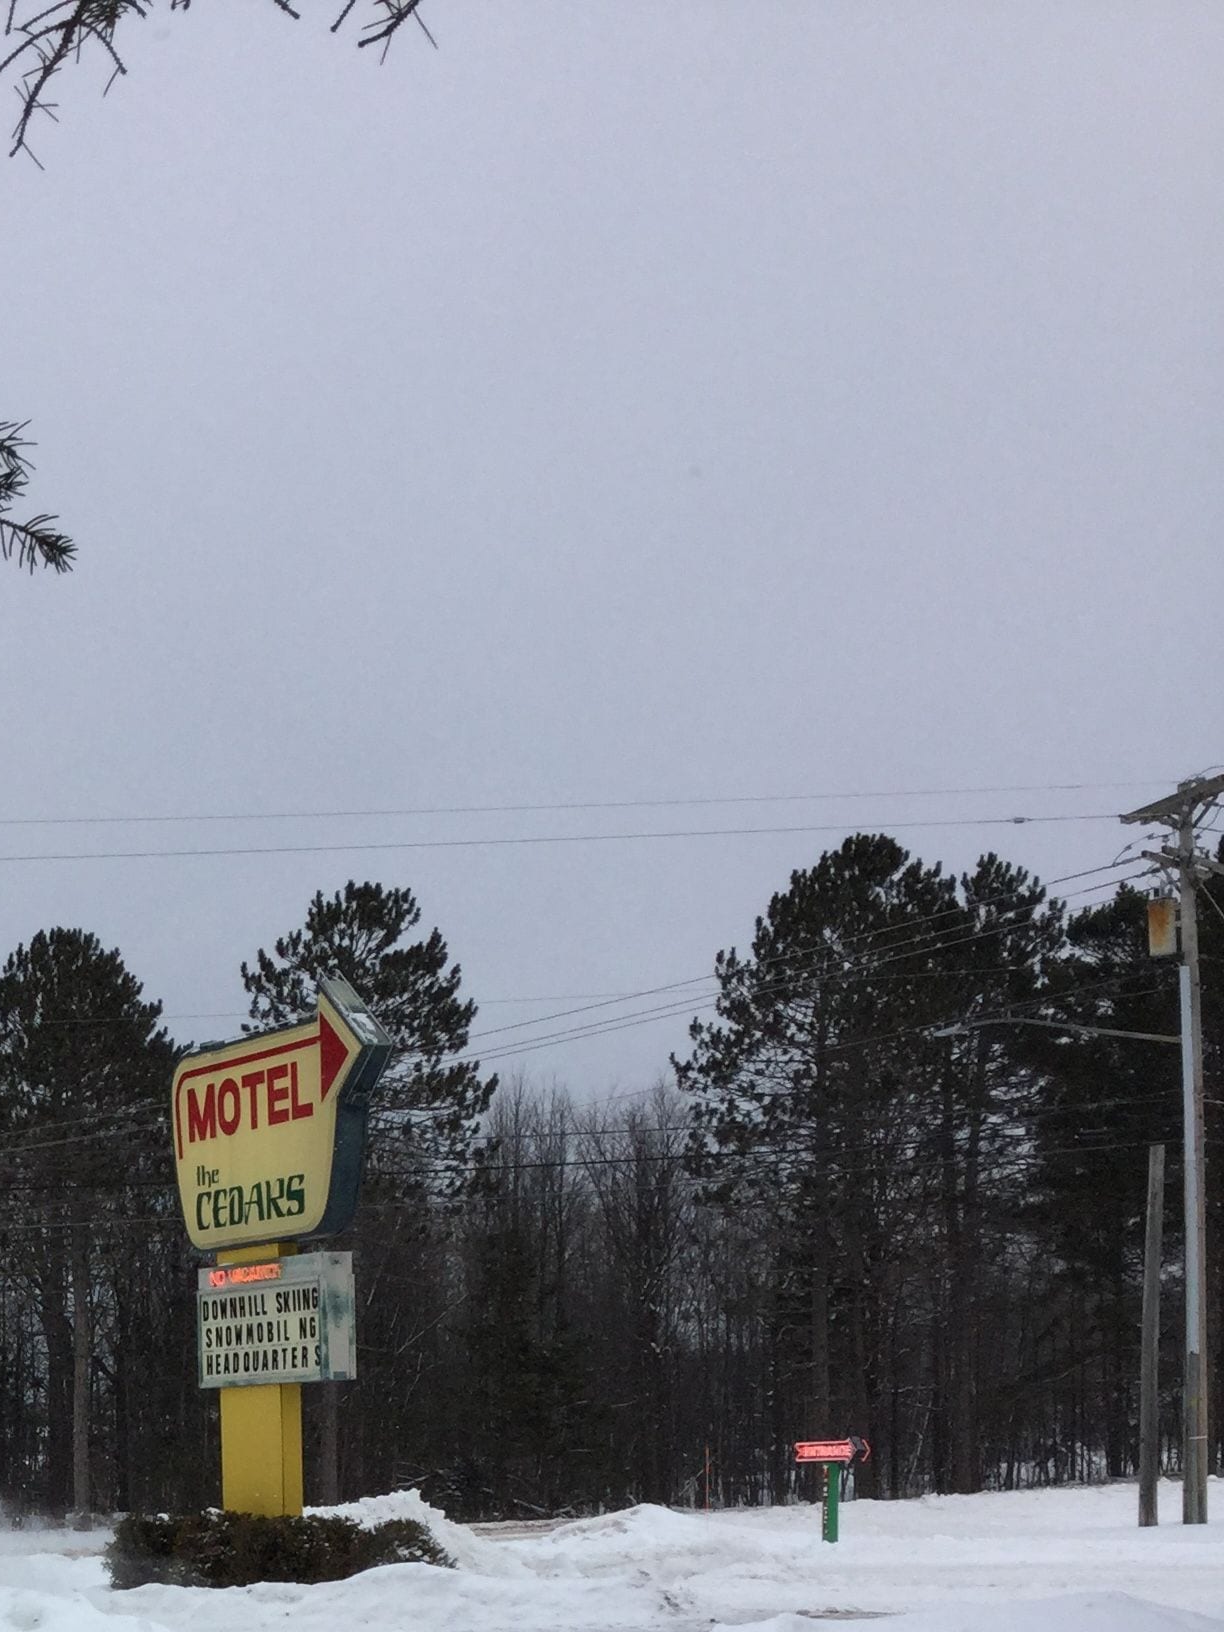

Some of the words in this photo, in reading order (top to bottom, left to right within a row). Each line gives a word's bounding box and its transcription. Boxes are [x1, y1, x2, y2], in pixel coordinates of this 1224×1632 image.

[187, 1061, 313, 1143] MOTEL
[196, 1165, 219, 1188] the
[196, 1174, 305, 1231] CEDARS
[203, 1294, 268, 1322] DOWNHILL
[276, 1287, 318, 1314] SKIING
[206, 1345, 321, 1376] HEADQUARTERS
